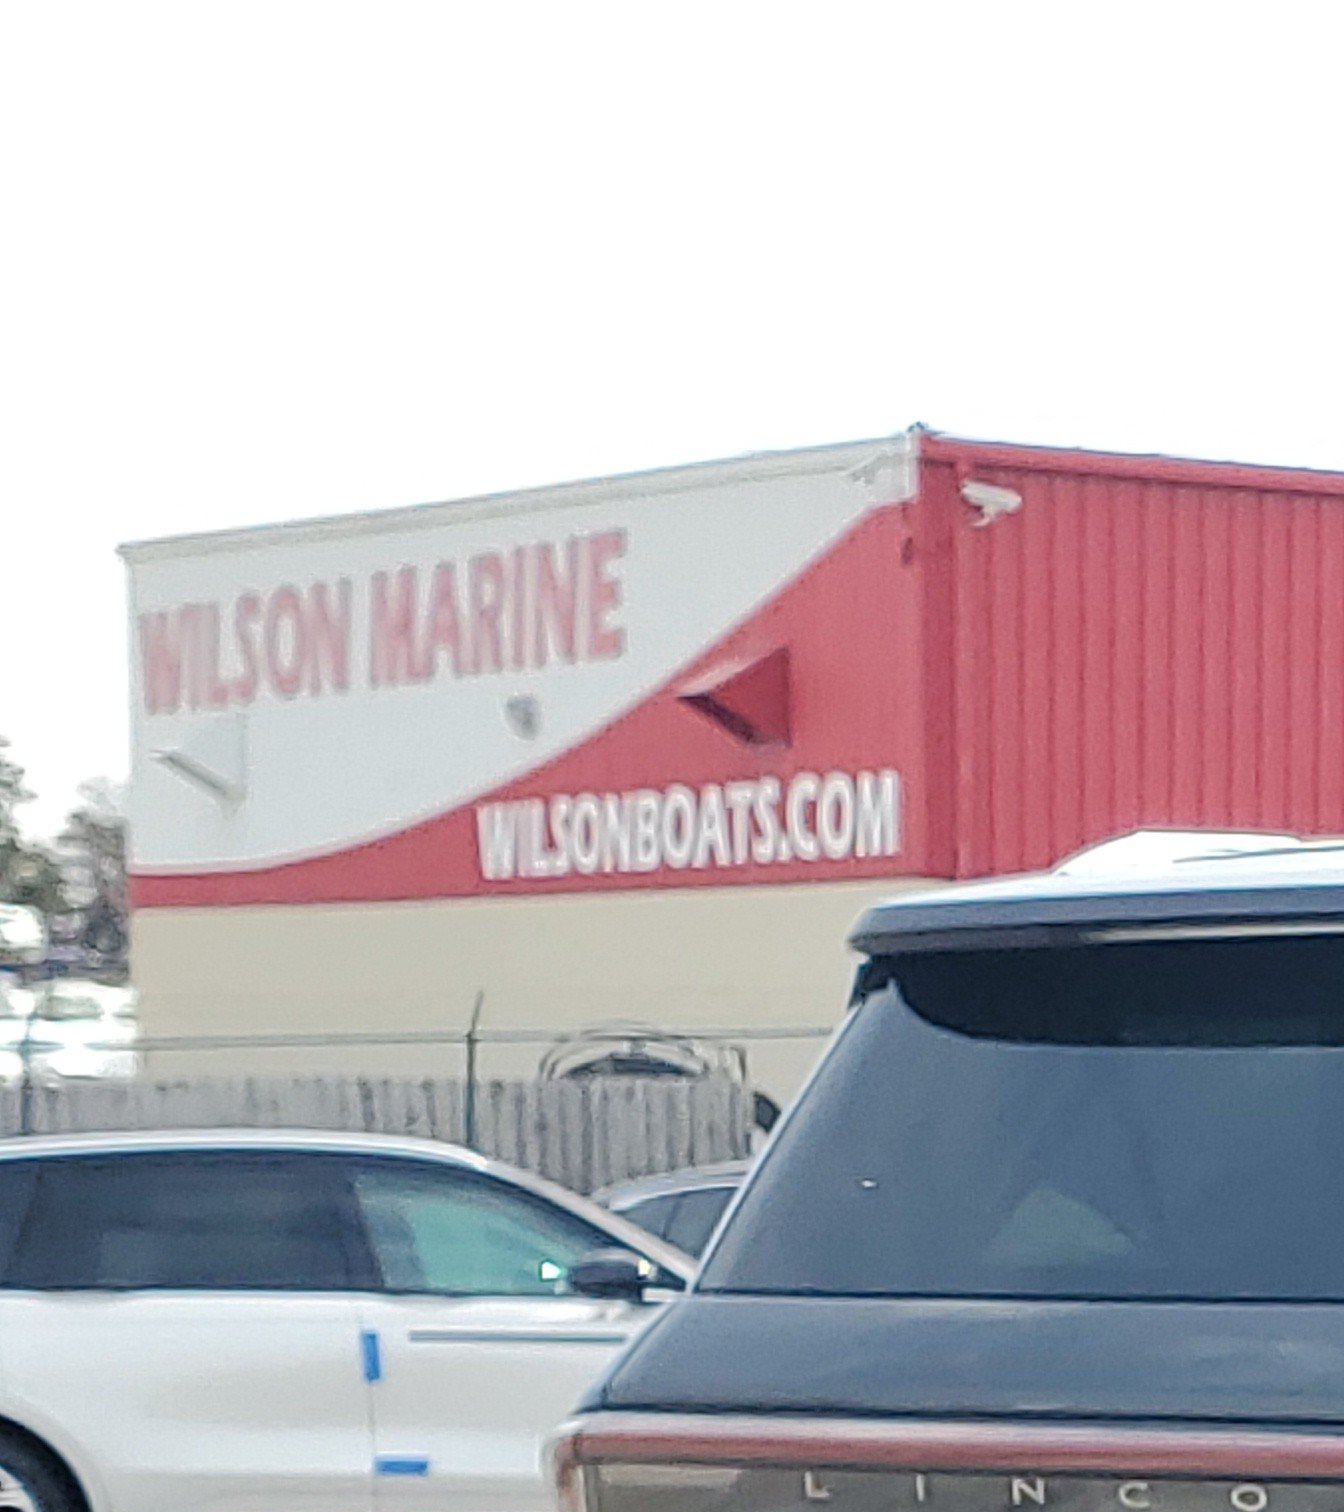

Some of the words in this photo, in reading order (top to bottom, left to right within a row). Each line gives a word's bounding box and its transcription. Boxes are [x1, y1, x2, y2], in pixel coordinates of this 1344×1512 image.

[138, 575, 352, 716] WILSON
[369, 530, 627, 687] MARINE
[477, 769, 902, 880] WILSONBOATS.COM
